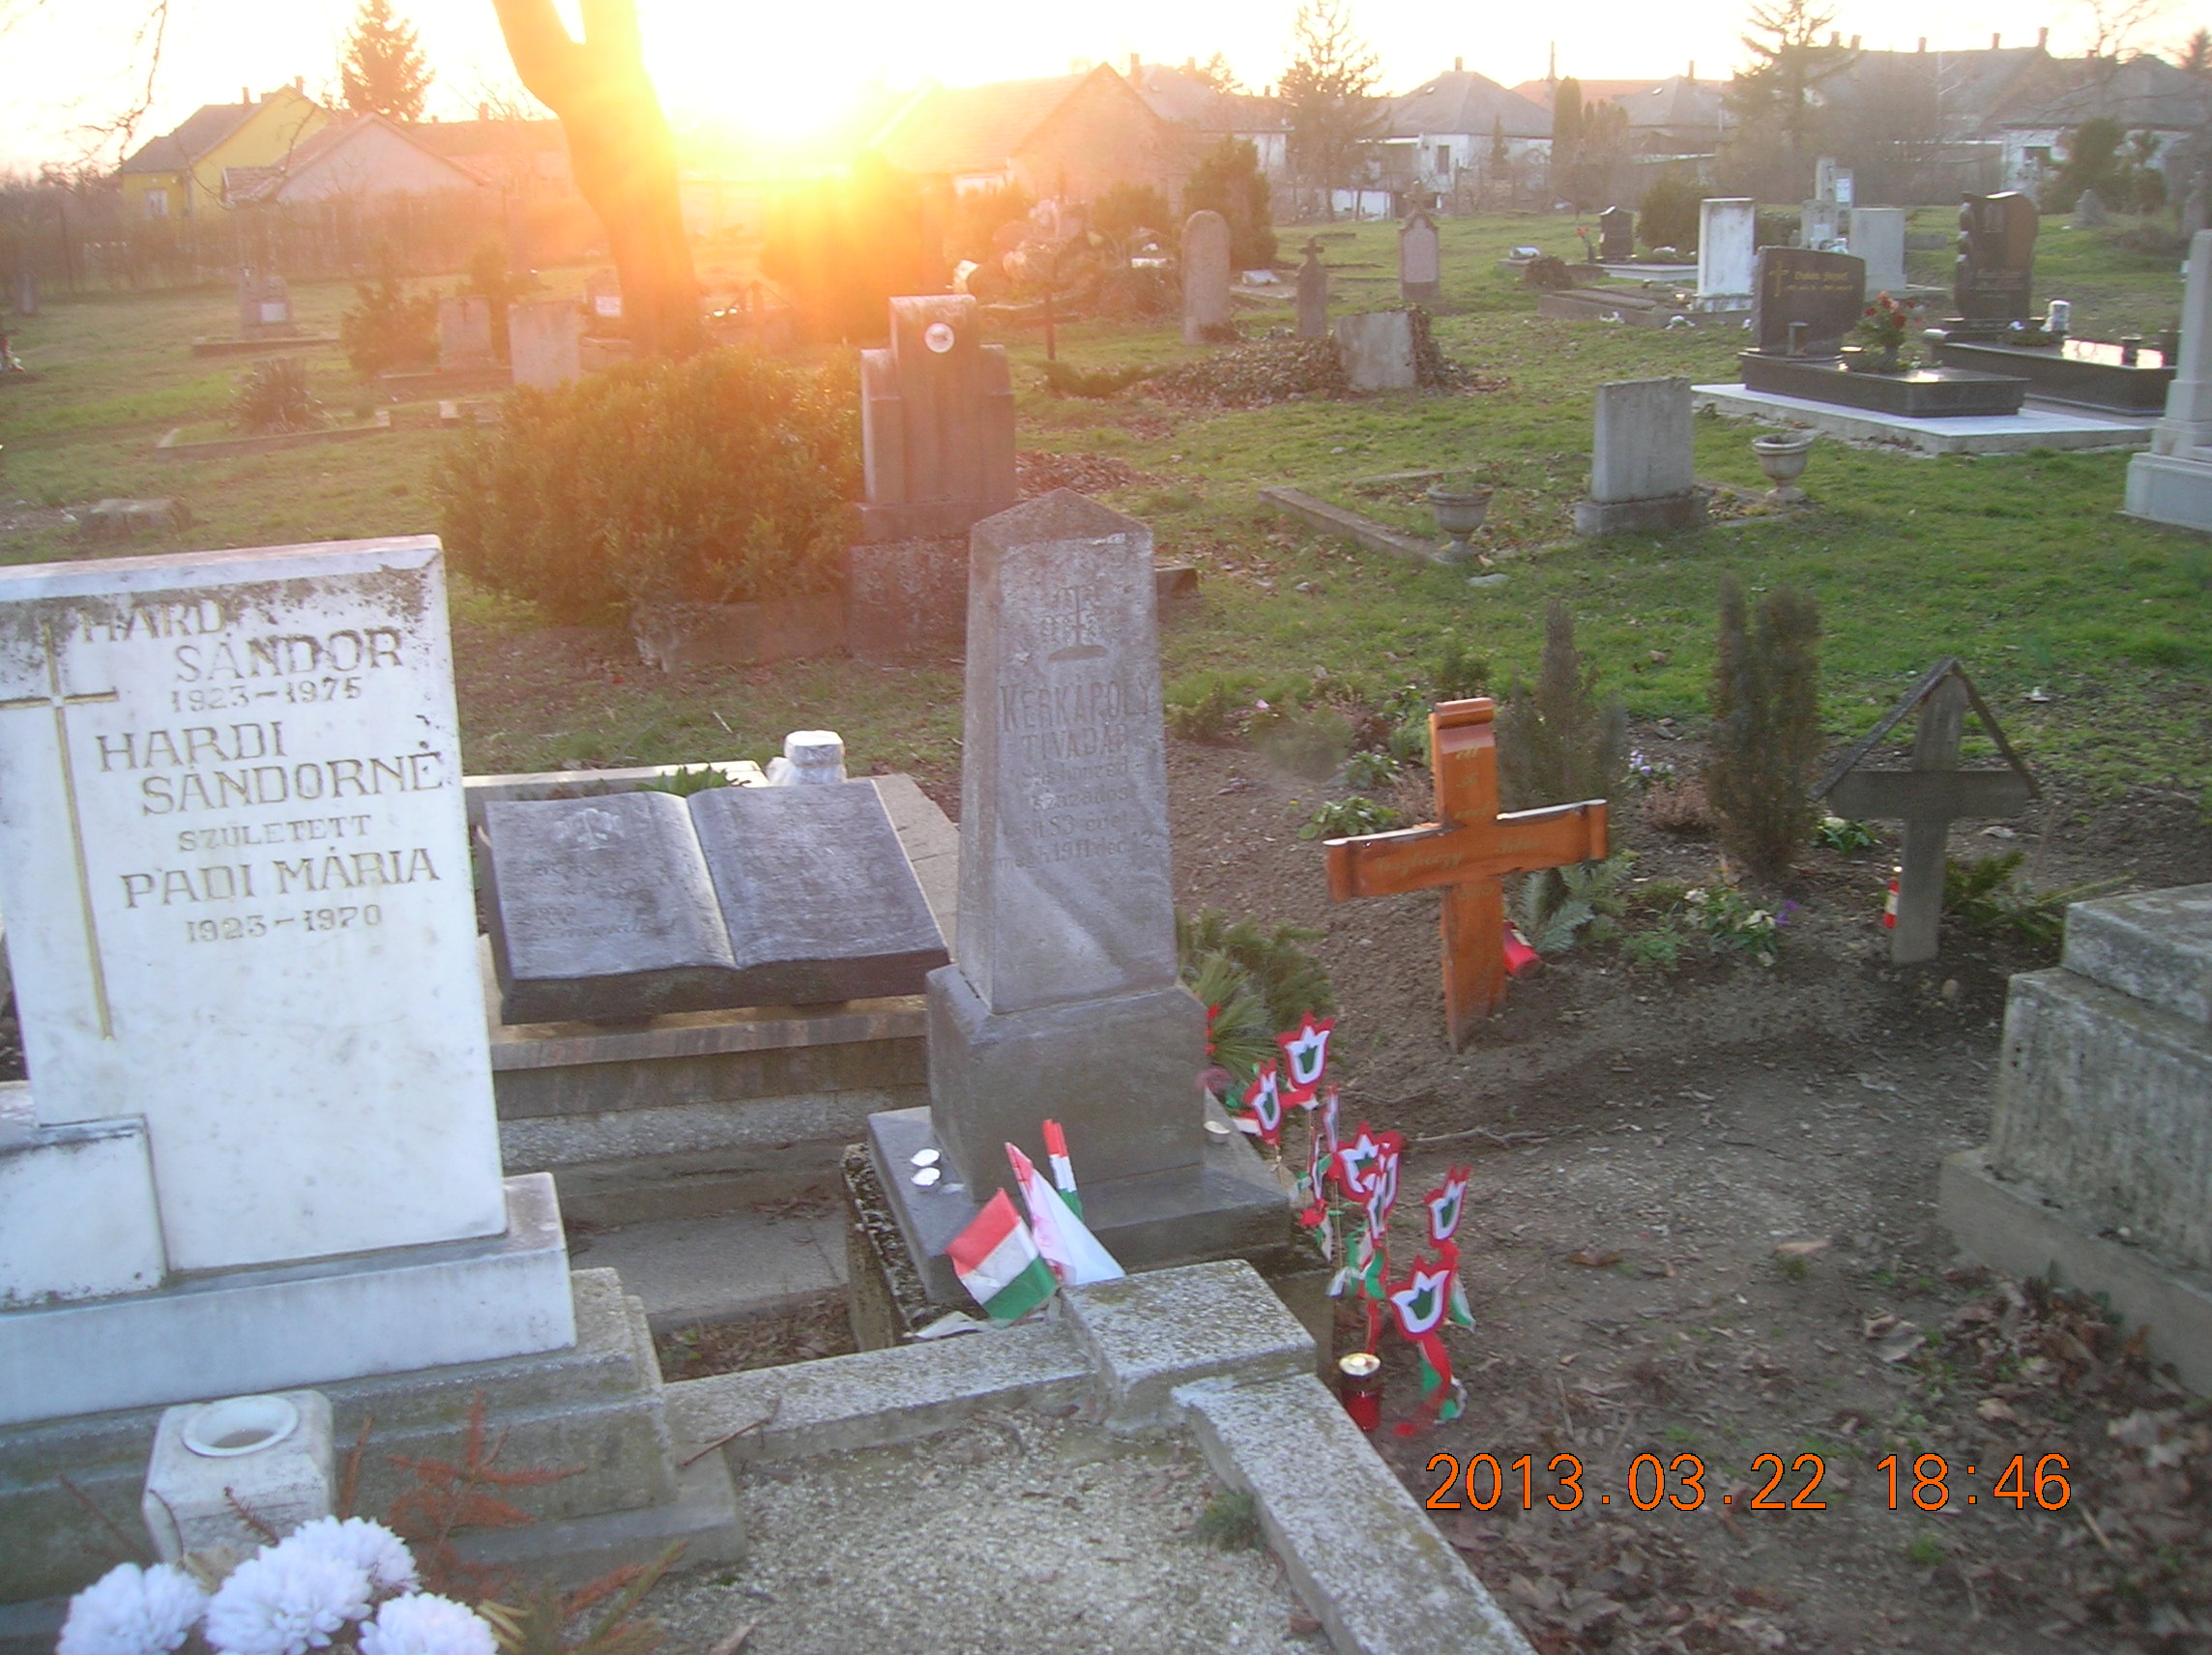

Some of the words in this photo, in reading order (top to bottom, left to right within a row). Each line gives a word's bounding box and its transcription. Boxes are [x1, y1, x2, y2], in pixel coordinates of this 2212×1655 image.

[176, 627, 403, 682] SÁNDOR
[97, 721, 288, 772] HARDI
[178, 814, 372, 854] SZÜLETETT
[120, 863, 257, 909] PADI
[272, 846, 441, 894] MÁRIA
